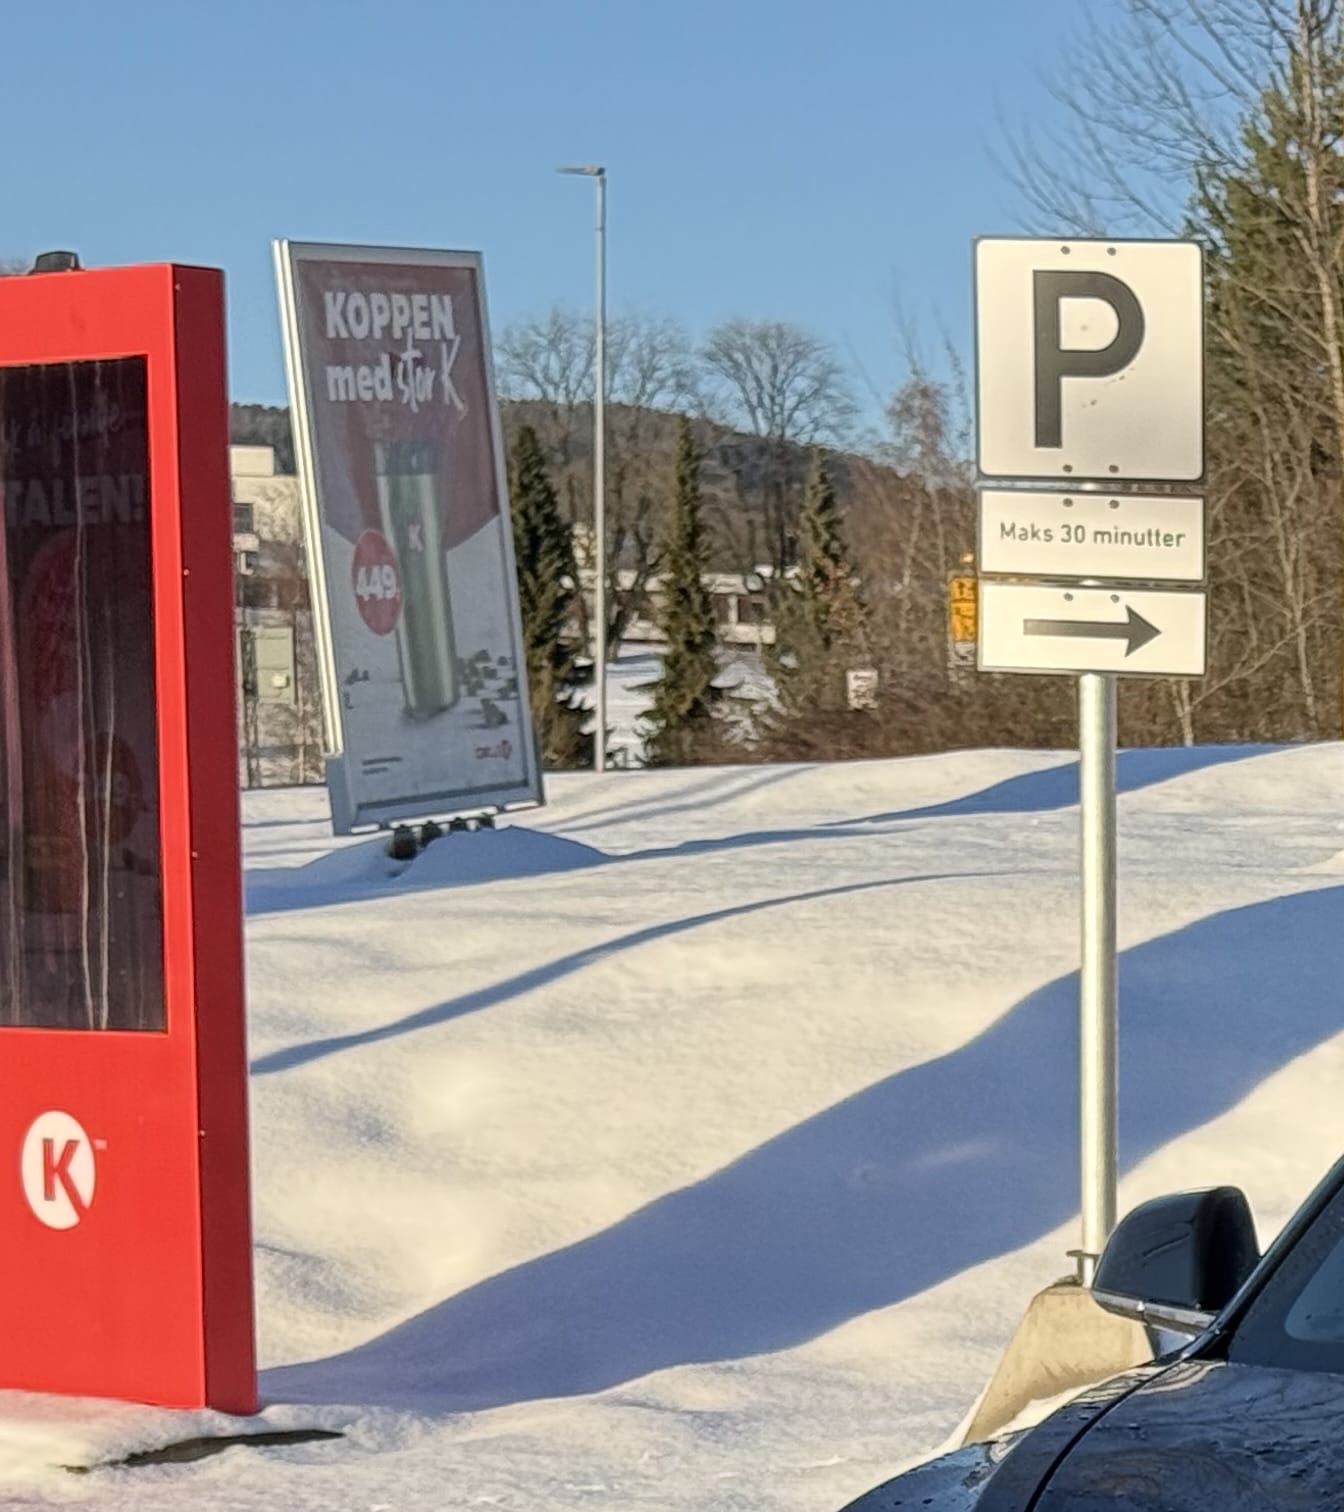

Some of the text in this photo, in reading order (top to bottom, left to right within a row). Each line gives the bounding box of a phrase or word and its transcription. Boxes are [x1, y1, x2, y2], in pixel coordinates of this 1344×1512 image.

[324, 291, 457, 341] KOPPEN
[325, 352, 395, 402] med
[396, 327, 437, 414] stor
[1032, 269, 1146, 449] P
[1000, 521, 1187, 548] Maks 30 minutter
[355, 563, 400, 602] 449
[42, 1138, 86, 1216] K
